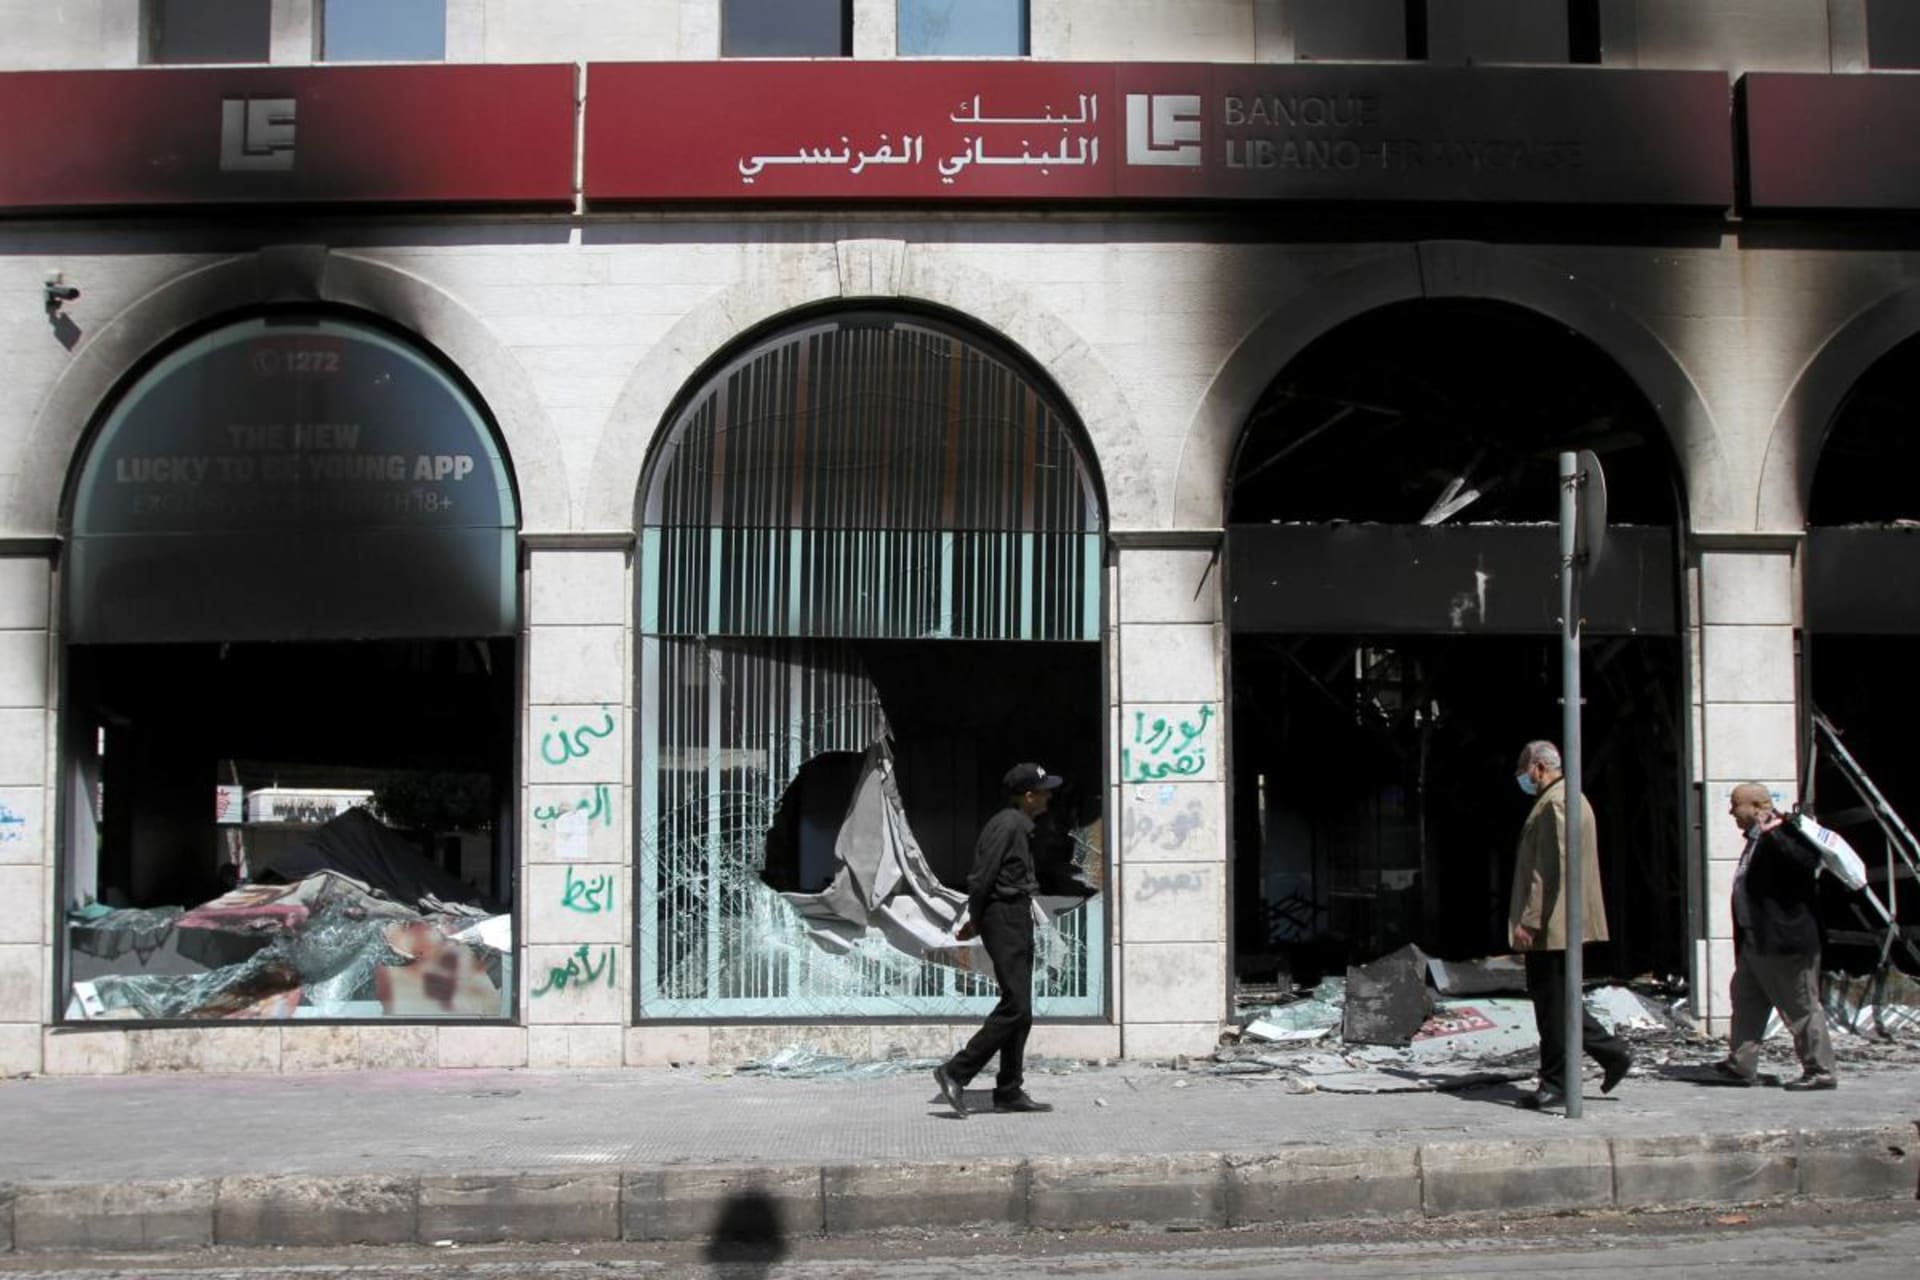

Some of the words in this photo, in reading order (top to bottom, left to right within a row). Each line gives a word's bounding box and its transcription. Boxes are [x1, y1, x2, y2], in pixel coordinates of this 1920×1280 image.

[949, 93, 1098, 132] البنك
[1223, 94, 1378, 128] BANQUE
[737, 134, 924, 184] الفرنسي
[937, 135, 1099, 184] اللبناني
[284, 351, 341, 373] 1272
[227, 423, 284, 450] THE
[293, 423, 361, 450] NEW
[115, 454, 209, 483] LUCKY
[216, 455, 255, 482] TO
[306, 454, 406, 481] YOUNG
[413, 454, 475, 482] APP
[415, 490, 454, 514] 18+
[561, 866, 614, 914] الخط
